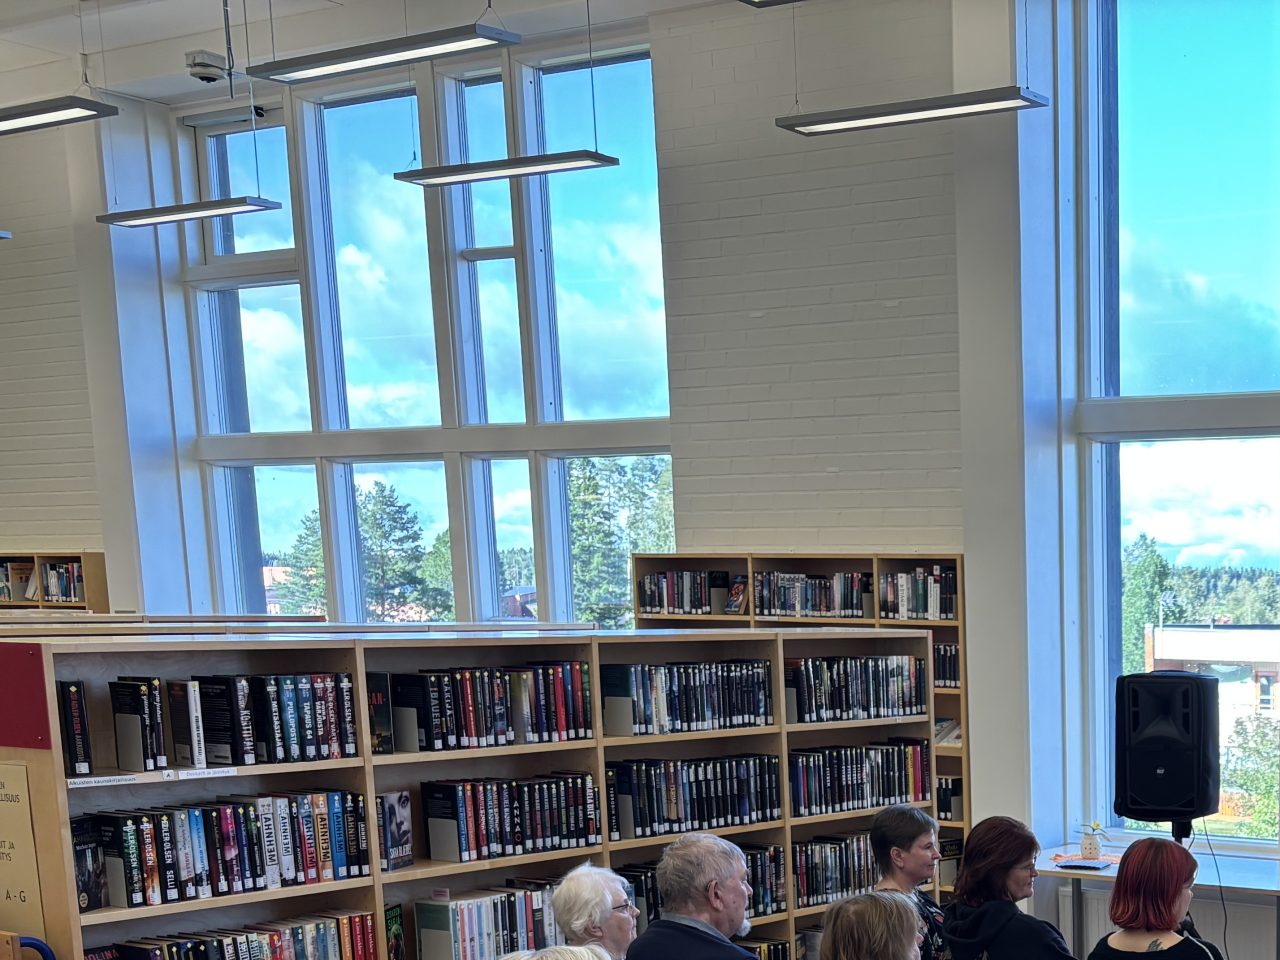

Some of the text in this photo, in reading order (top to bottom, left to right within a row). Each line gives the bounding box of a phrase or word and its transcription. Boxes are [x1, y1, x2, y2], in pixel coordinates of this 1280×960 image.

[271, 701, 284, 748] METSÄSTÄJÄ
[303, 702, 313, 739] TAPAUS 64
[315, 701, 324, 736] VARJOISTA
[513, 800, 521, 832] ANNA
[128, 824, 138, 867] DLER-OLSEN
[144, 824, 154, 866] DLER-OLSEN
[6, 889, 12, 900] A
[19, 890, 26, 902] G
[166, 870, 174, 888] SELLI
